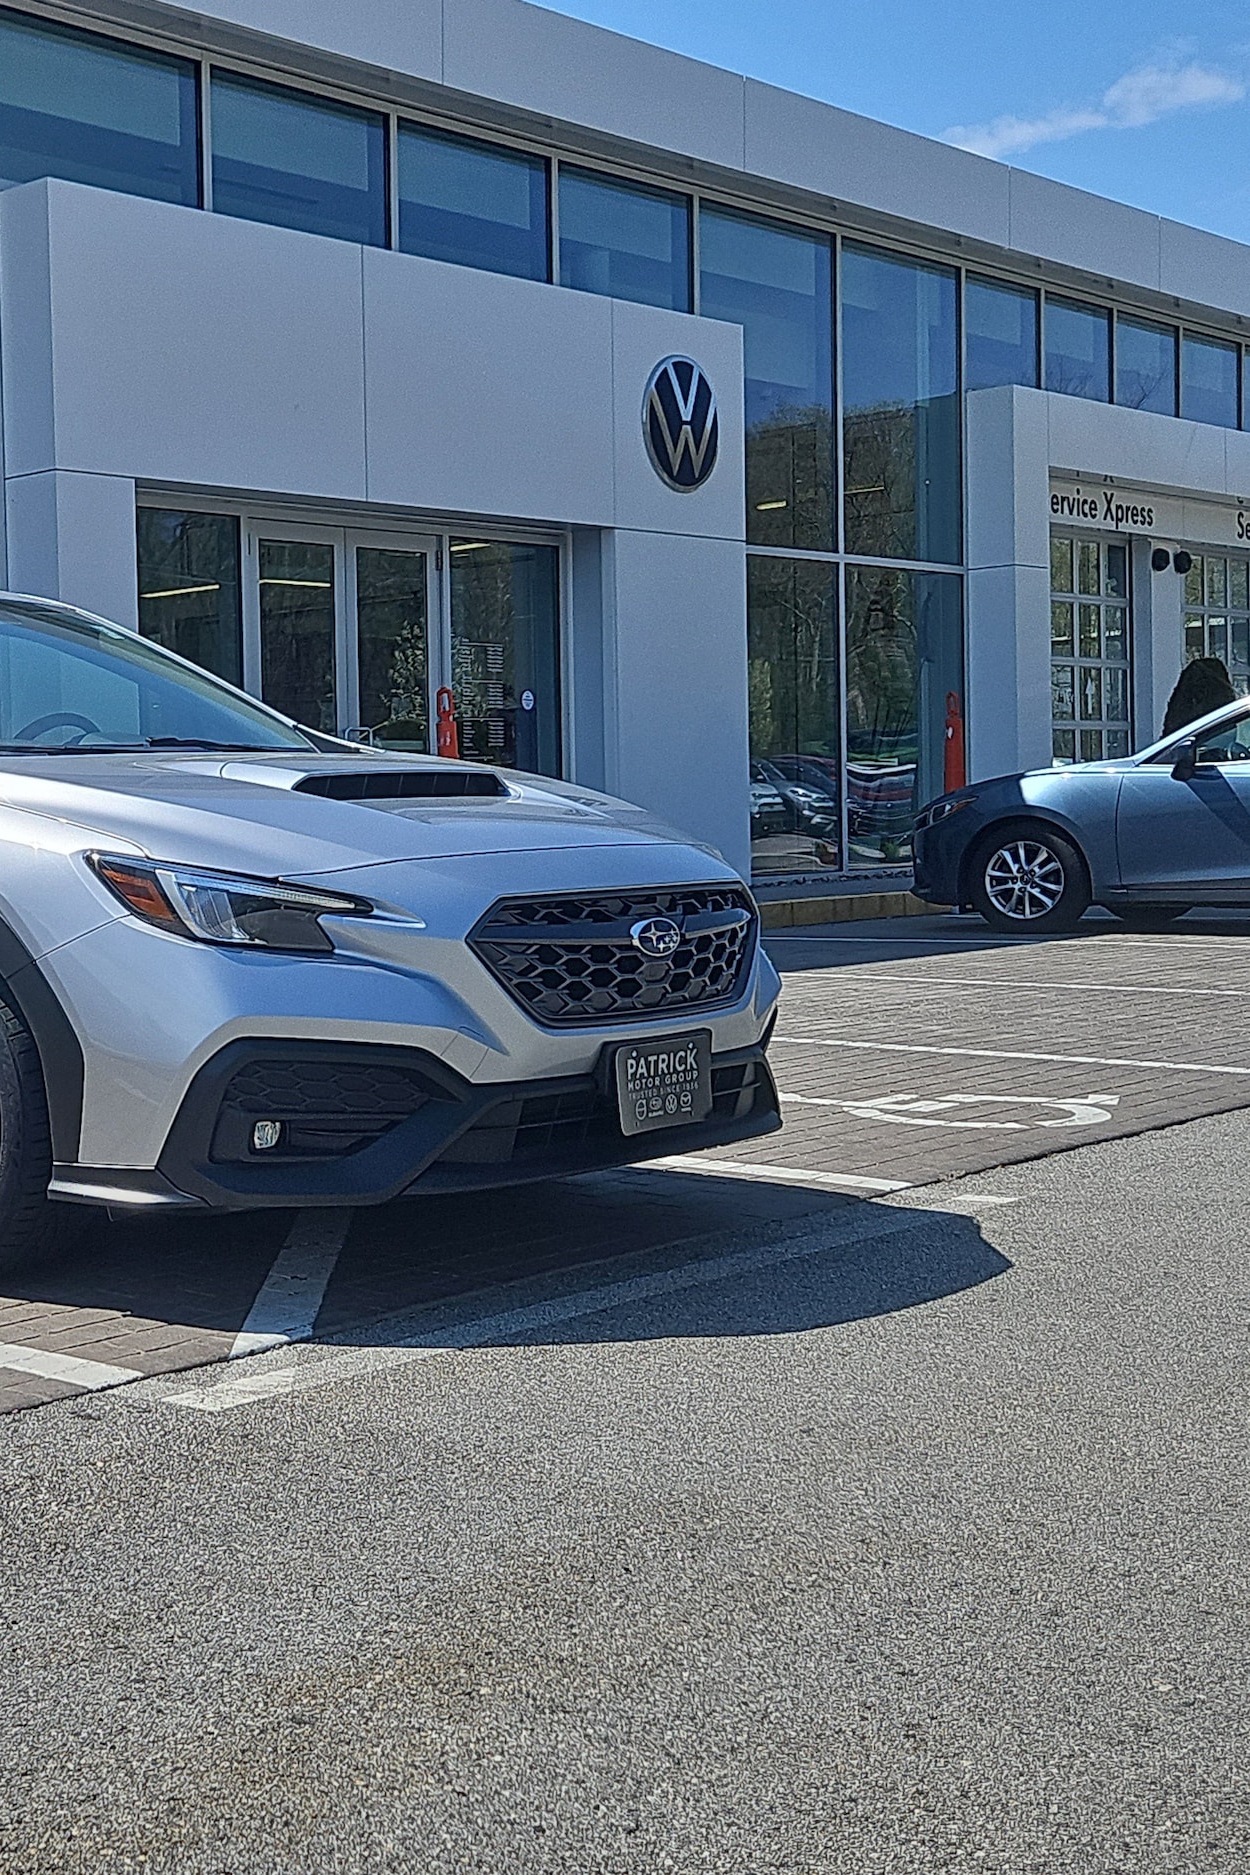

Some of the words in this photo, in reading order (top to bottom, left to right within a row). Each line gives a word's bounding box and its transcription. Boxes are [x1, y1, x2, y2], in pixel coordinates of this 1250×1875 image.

[1103, 492, 1154, 529] Xpress
[627, 1048, 698, 1080] PATRICK
[627, 1076, 661, 1092] MOTOR
[664, 1070, 699, 1085] GROUP
[628, 1087, 658, 1100] TRUSTED
[660, 1083, 680, 1095] SINCE
